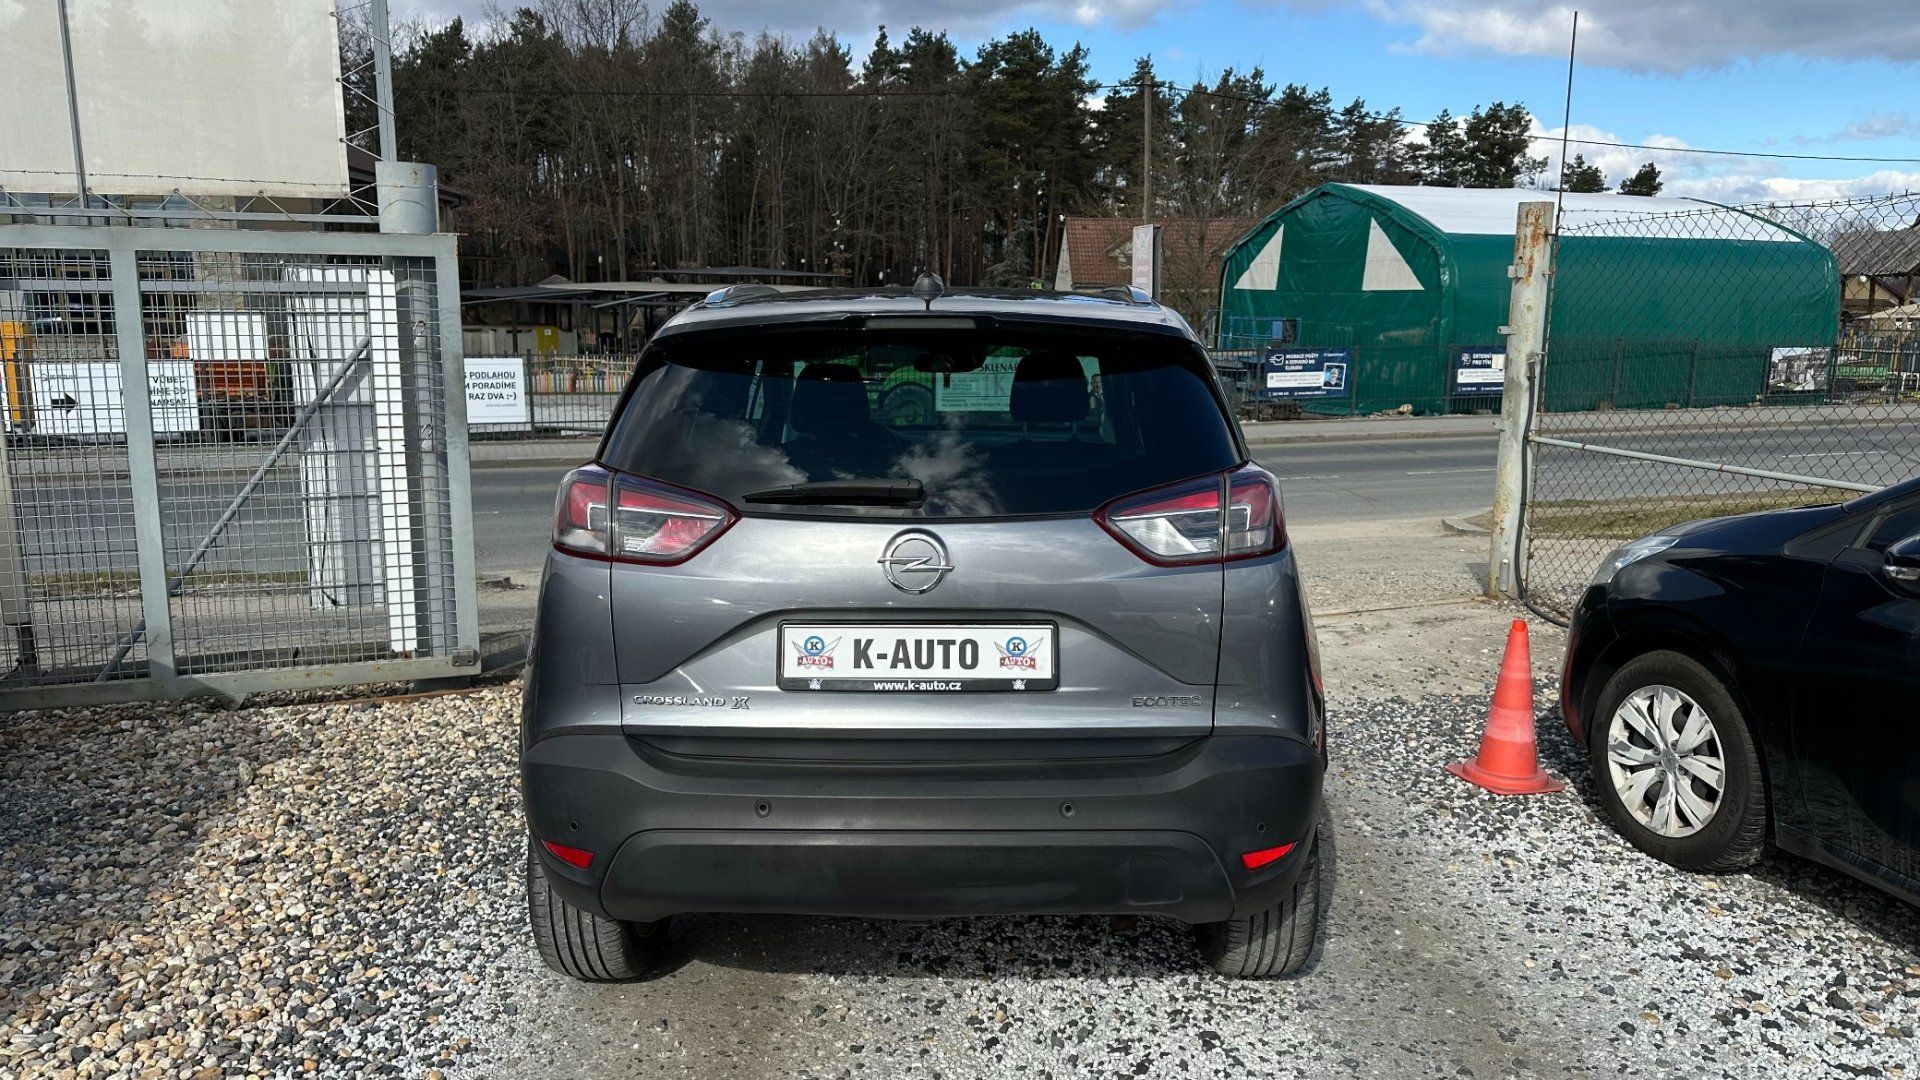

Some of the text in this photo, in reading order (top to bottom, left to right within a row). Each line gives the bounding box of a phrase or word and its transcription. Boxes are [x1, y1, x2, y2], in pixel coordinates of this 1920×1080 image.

[469, 371, 516, 379] PODLAHOU
[472, 380, 517, 390] PORADÍME
[468, 392, 485, 400] RAZ
[487, 392, 504, 400] DVA
[809, 641, 821, 651] K
[1011, 641, 1021, 651] K
[853, 638, 979, 670] K-AUTO
[802, 656, 829, 665] AUTO
[1003, 656, 1033, 666] AUTO
[873, 680, 962, 691] www.k-auto.cz
[632, 695, 750, 709] CROSSLAND X
[1131, 695, 1202, 708] ECOTEC
